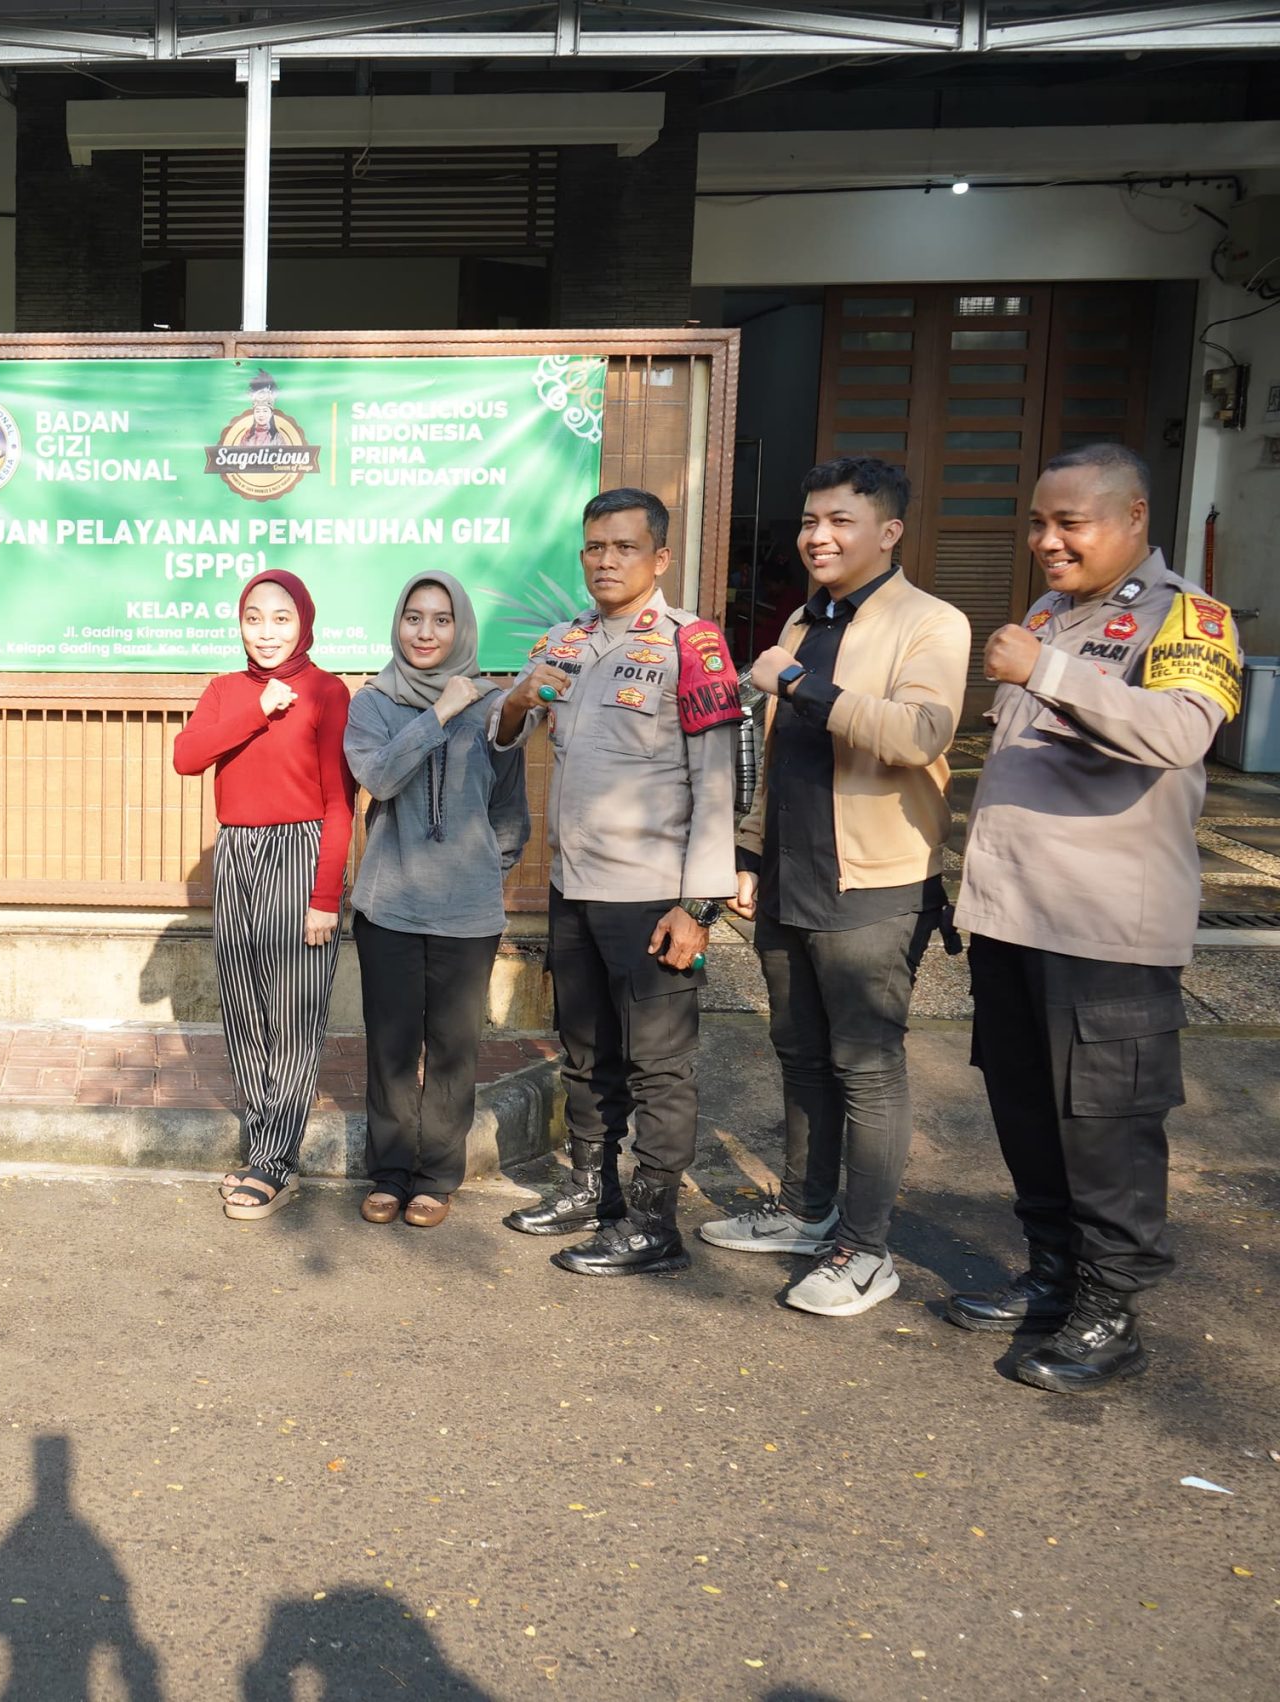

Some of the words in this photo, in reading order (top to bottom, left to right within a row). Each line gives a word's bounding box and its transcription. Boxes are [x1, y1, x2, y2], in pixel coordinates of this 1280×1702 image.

[351, 400, 509, 420] SAGOLICIOUS
[36, 410, 129, 433] BADAN
[351, 423, 483, 442] INDONESIA
[36, 435, 91, 457] GIZI
[351, 446, 426, 464] PRIMA
[216, 447, 310, 471] Sagolicious
[36, 458, 178, 482] NASIONAL
[351, 467, 507, 486] FOUNDATION
[57, 518, 240, 546] PELAYANAN
[249, 518, 444, 545] PEMENUHAN
[452, 517, 511, 544] GIZI
[165, 550, 266, 581] (SPPG)
[127, 601, 210, 619] KELAPA
[63, 626, 79, 639] Jl.
[81, 626, 133, 641] Gading
[136, 626, 182, 639] Kirana
[186, 626, 225, 639] Barat
[322, 628, 343, 639] Rw
[7, 641, 55, 657] Kelapa
[59, 641, 110, 658] Gading
[191, 642, 241, 658] Kelapa
[1079, 640, 1130, 662] POLRI
[613, 665, 664, 685] POLRI
